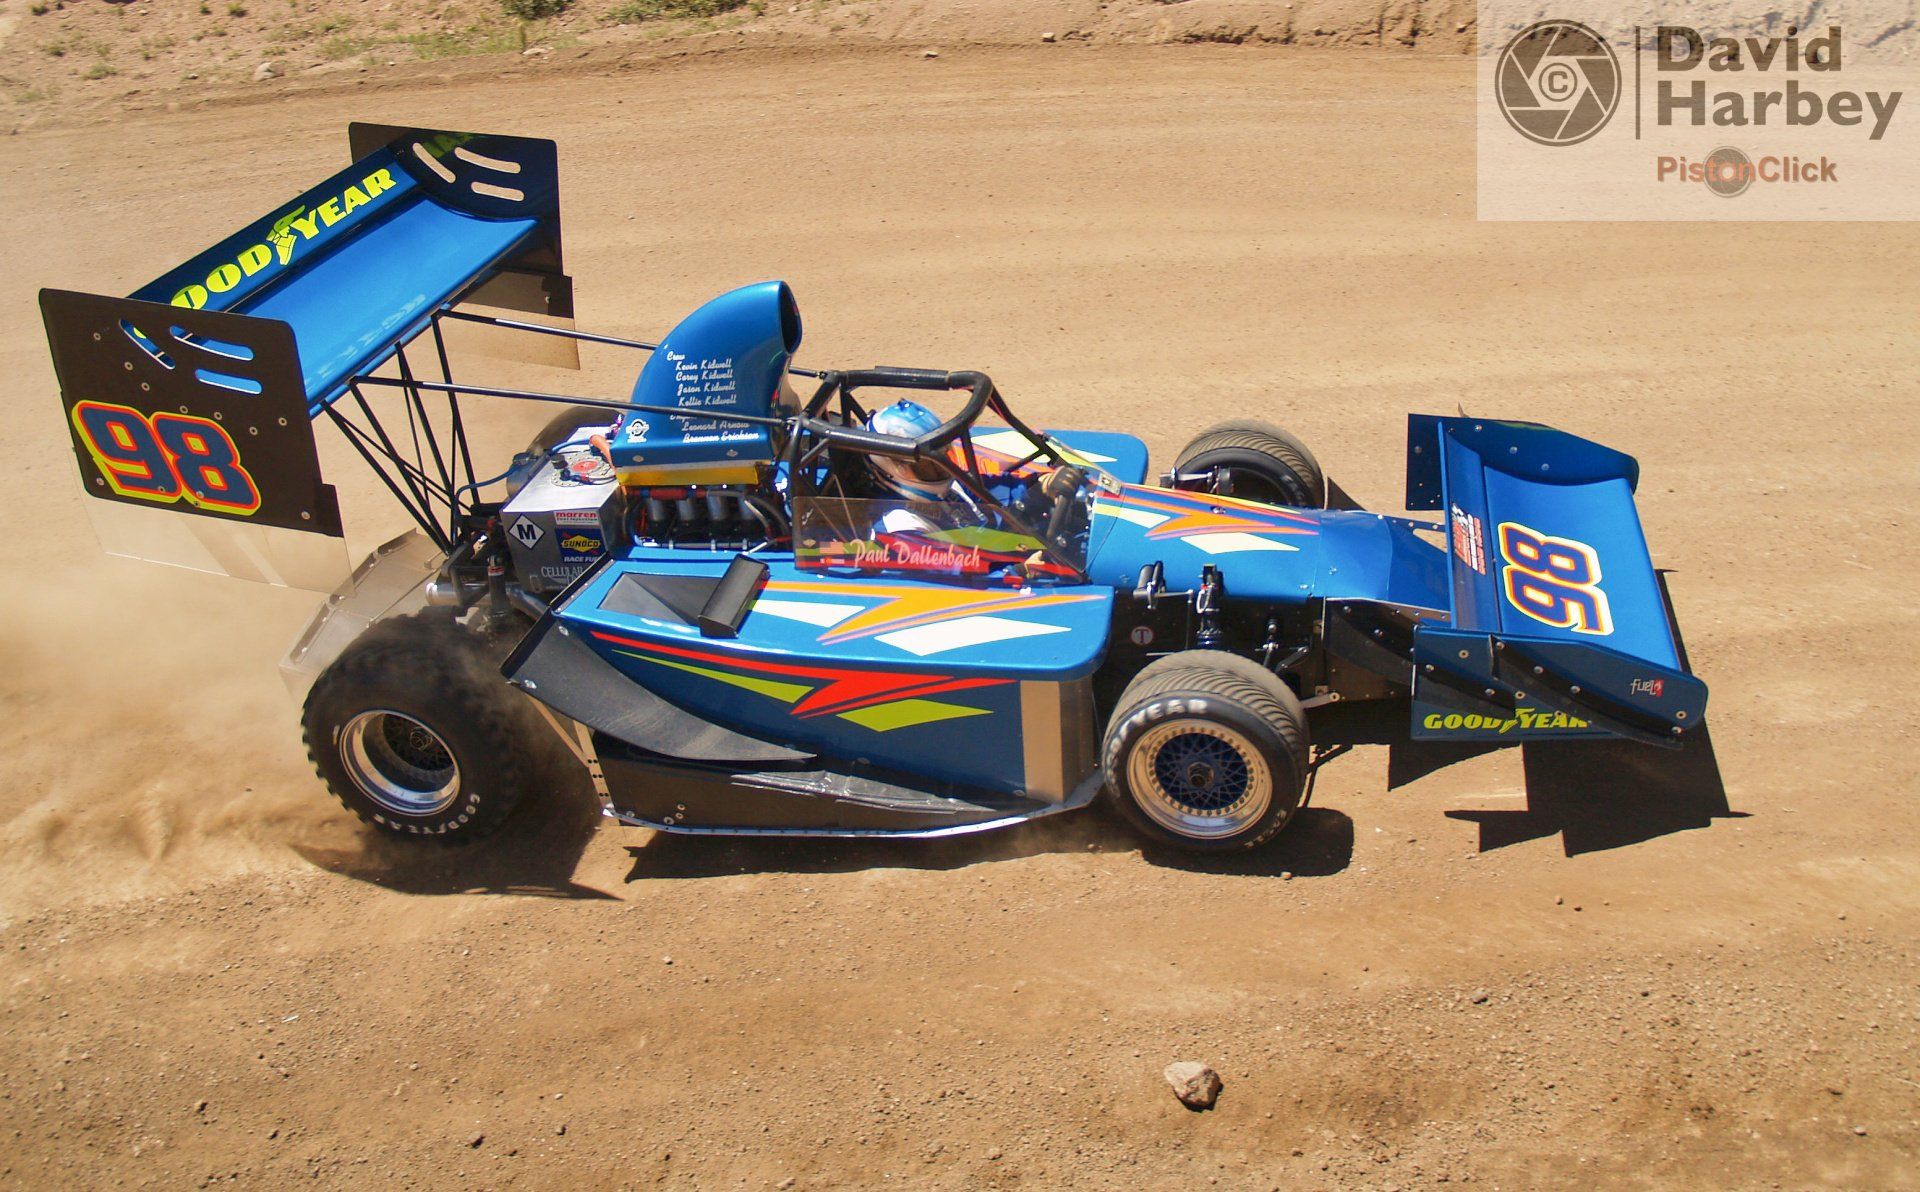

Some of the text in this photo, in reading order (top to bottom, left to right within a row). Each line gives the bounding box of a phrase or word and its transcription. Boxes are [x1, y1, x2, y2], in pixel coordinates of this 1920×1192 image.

[171, 168, 396, 310] OODYEAR
[675, 358, 732, 371] Kevin Kidwell
[675, 369, 733, 382] Corey Kidwell
[677, 380, 736, 396] Jason Kidwell
[705, 395, 737, 406] Kidwell
[681, 420, 717, 432] Leonard
[71, 400, 261, 516] 98
[555, 511, 597, 519] marren
[516, 524, 537, 540] M
[562, 540, 599, 548] SUNOCO
[850, 538, 980, 568] Paul Dallenbach
[1497, 521, 1614, 635] 98
